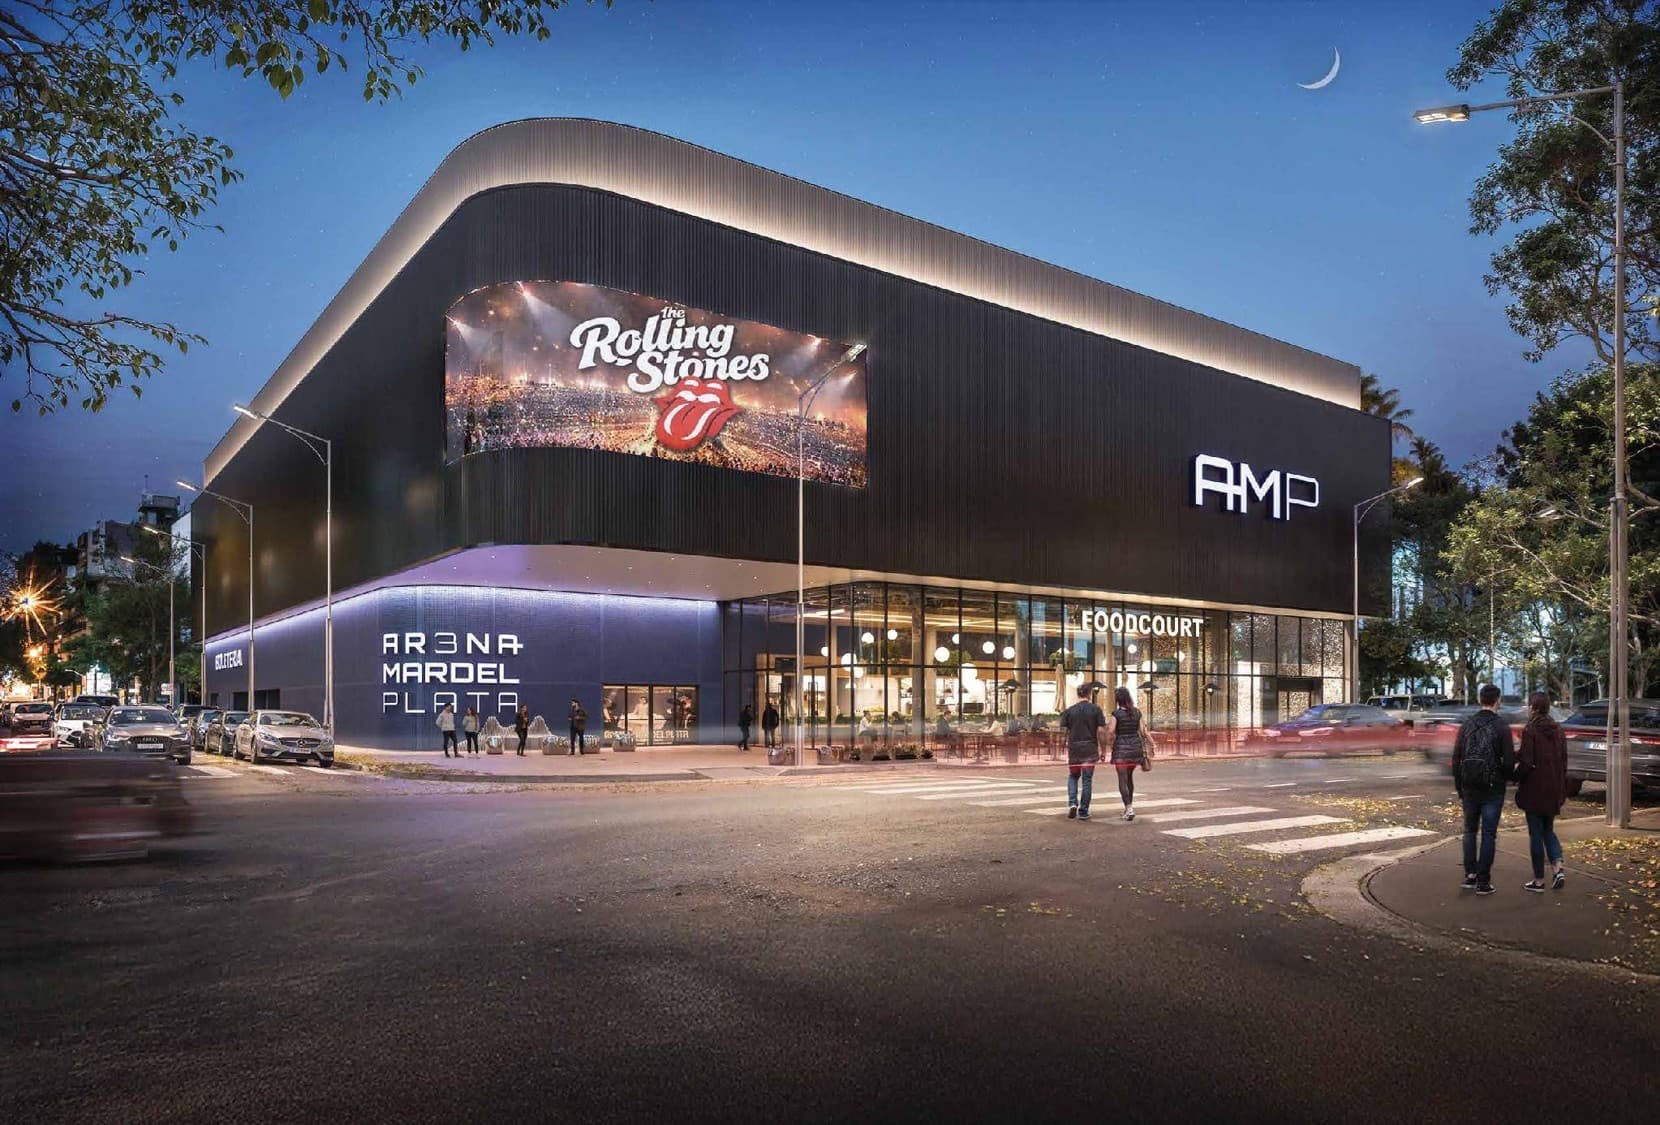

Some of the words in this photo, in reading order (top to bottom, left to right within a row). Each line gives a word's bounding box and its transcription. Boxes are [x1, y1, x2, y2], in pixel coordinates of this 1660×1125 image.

[569, 315, 735, 370] Rolling
[627, 350, 770, 393] Stones
[1195, 454, 1319, 521] AMP
[1081, 610, 1204, 637] FOODCOURT
[383, 632, 523, 654] AR3NA
[383, 662, 520, 684] MARDEL
[382, 692, 518, 713] PLATA
